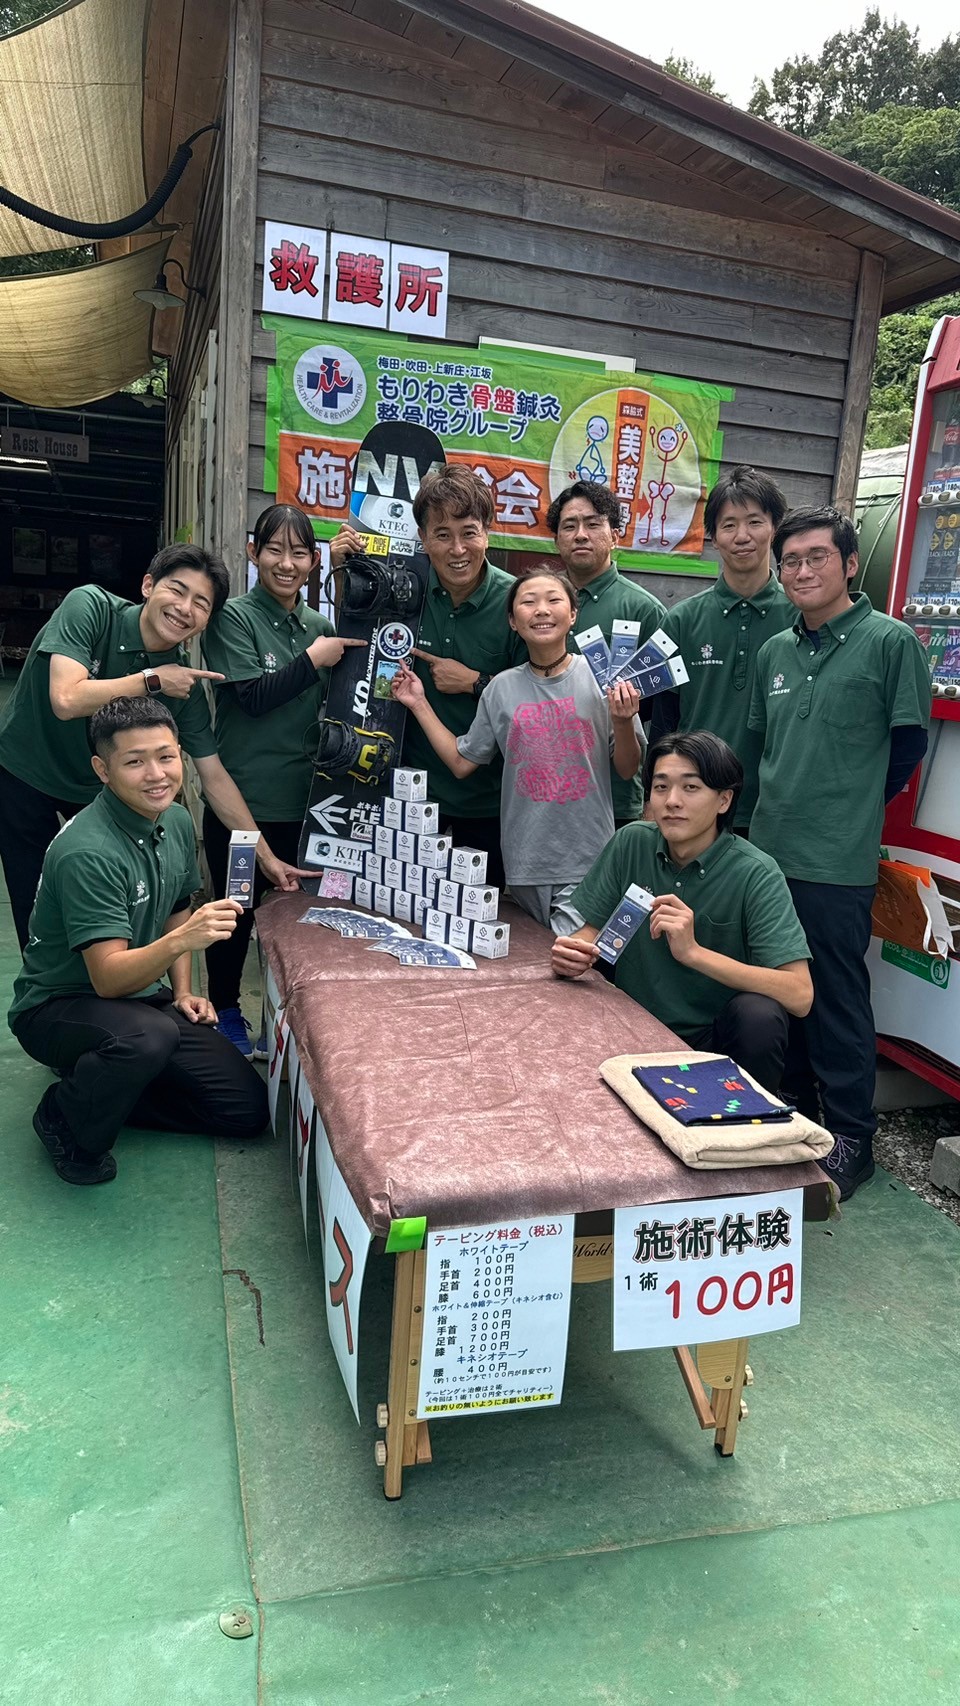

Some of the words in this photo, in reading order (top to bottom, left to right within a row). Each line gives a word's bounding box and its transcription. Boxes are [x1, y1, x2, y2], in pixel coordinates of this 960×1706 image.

[269, 239, 443, 317] 救護所
[378, 356, 492, 379] 梅田・吹田・上新庄・江坂
[297, 375, 308, 402] HEALTH
[306, 401, 323, 417] CARE
[330, 383, 363, 420] REVITALIZATION
[377, 375, 561, 422] もりわき骨盤鍼灸
[376, 402, 528, 441] 整骨院グループ
[12, 433, 39, 453] Rest
[45, 437, 78, 457] House
[379, 520, 408, 533] KTEC
[373, 537, 387, 545] RIDE
[372, 545, 386, 554] LIFE
[633, 1207, 792, 1263] 施術体験
[460, 1241, 529, 1257] ホワイトテープ
[573, 1242, 612, 1258] World
[440, 1259, 450, 1269] 指
[440, 1269, 460, 1280] 手首
[439, 1281, 460, 1292] 足首
[624, 1272, 659, 1291] 1術
[665, 1263, 793, 1319] 100円
[438, 1293, 449, 1303] 膝
[437, 1316, 447, 1326] 指
[437, 1325, 457, 1336] 手首
[436, 1336, 457, 1347] 足首
[435, 1347, 445, 1357] 膝
[457, 1349, 528, 1364] キネシオテープ
[433, 1368, 444, 1378] 腰
